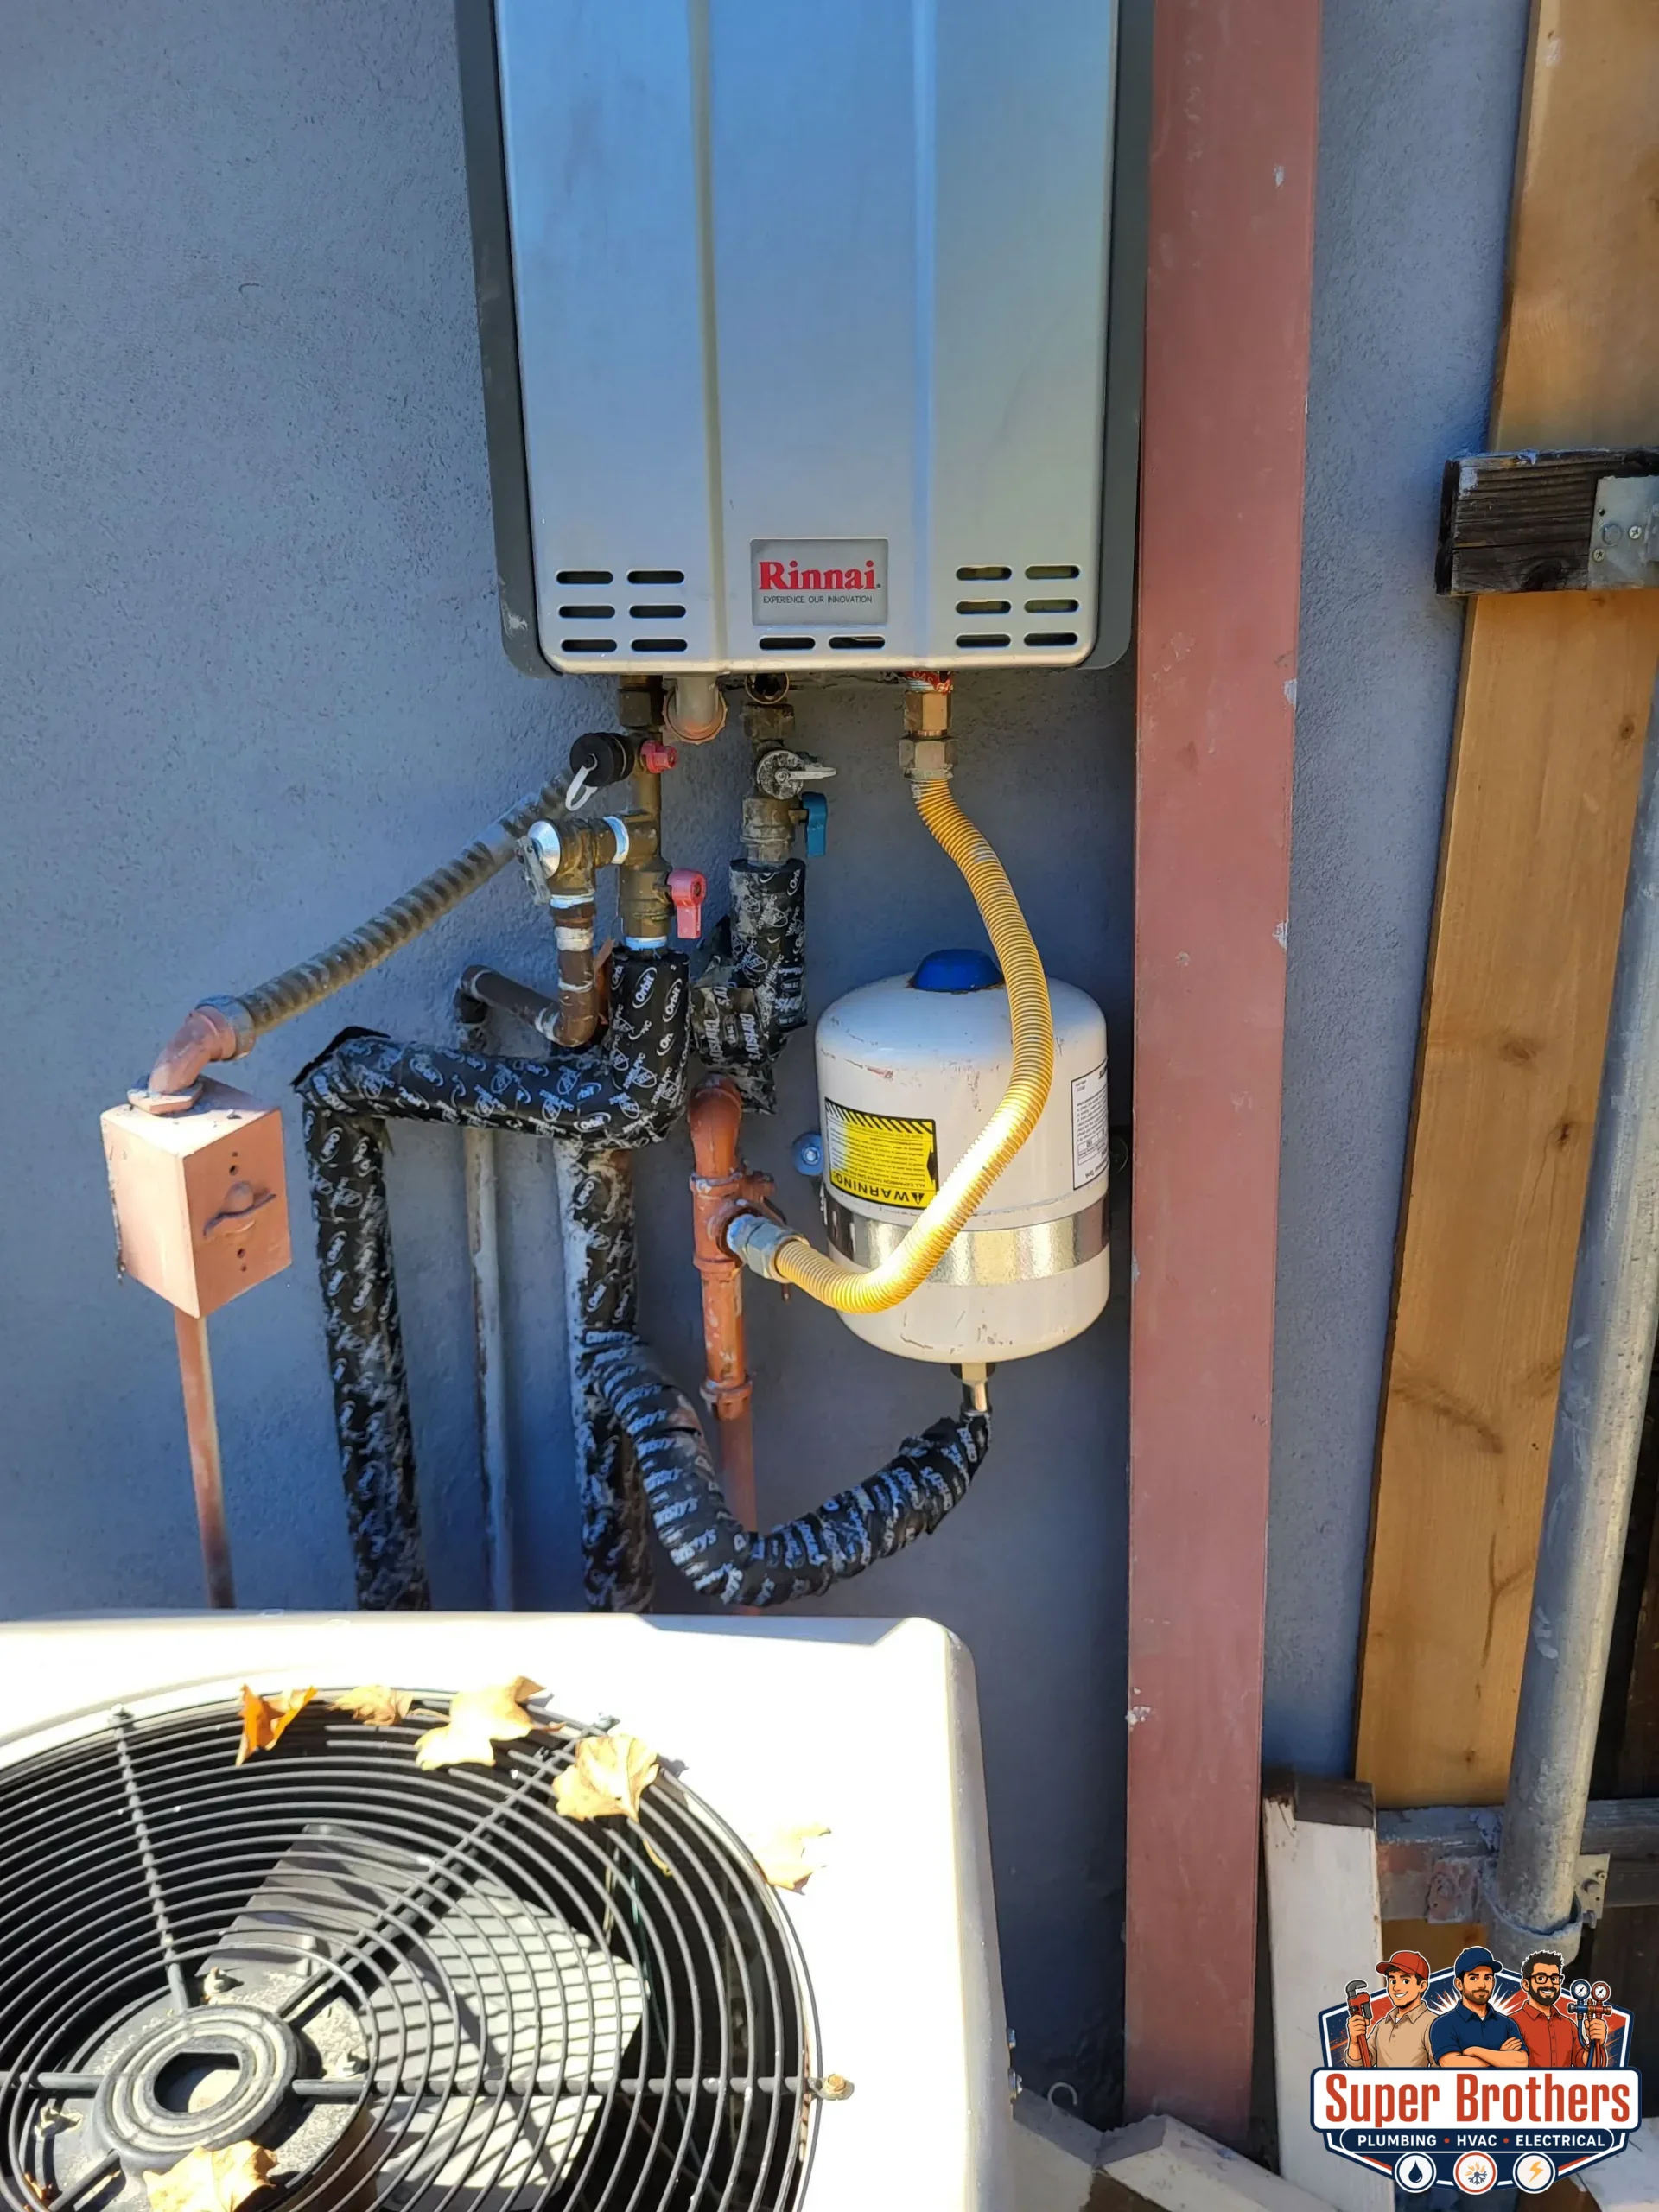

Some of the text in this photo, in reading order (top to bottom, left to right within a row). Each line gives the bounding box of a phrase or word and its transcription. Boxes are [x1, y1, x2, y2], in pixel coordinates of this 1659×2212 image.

[759, 560, 876, 590] Rinnai
[763, 595, 804, 604] EXPERIENCE
[635, 973, 655, 1002] Orbit
[665, 987, 682, 1015] Orbit
